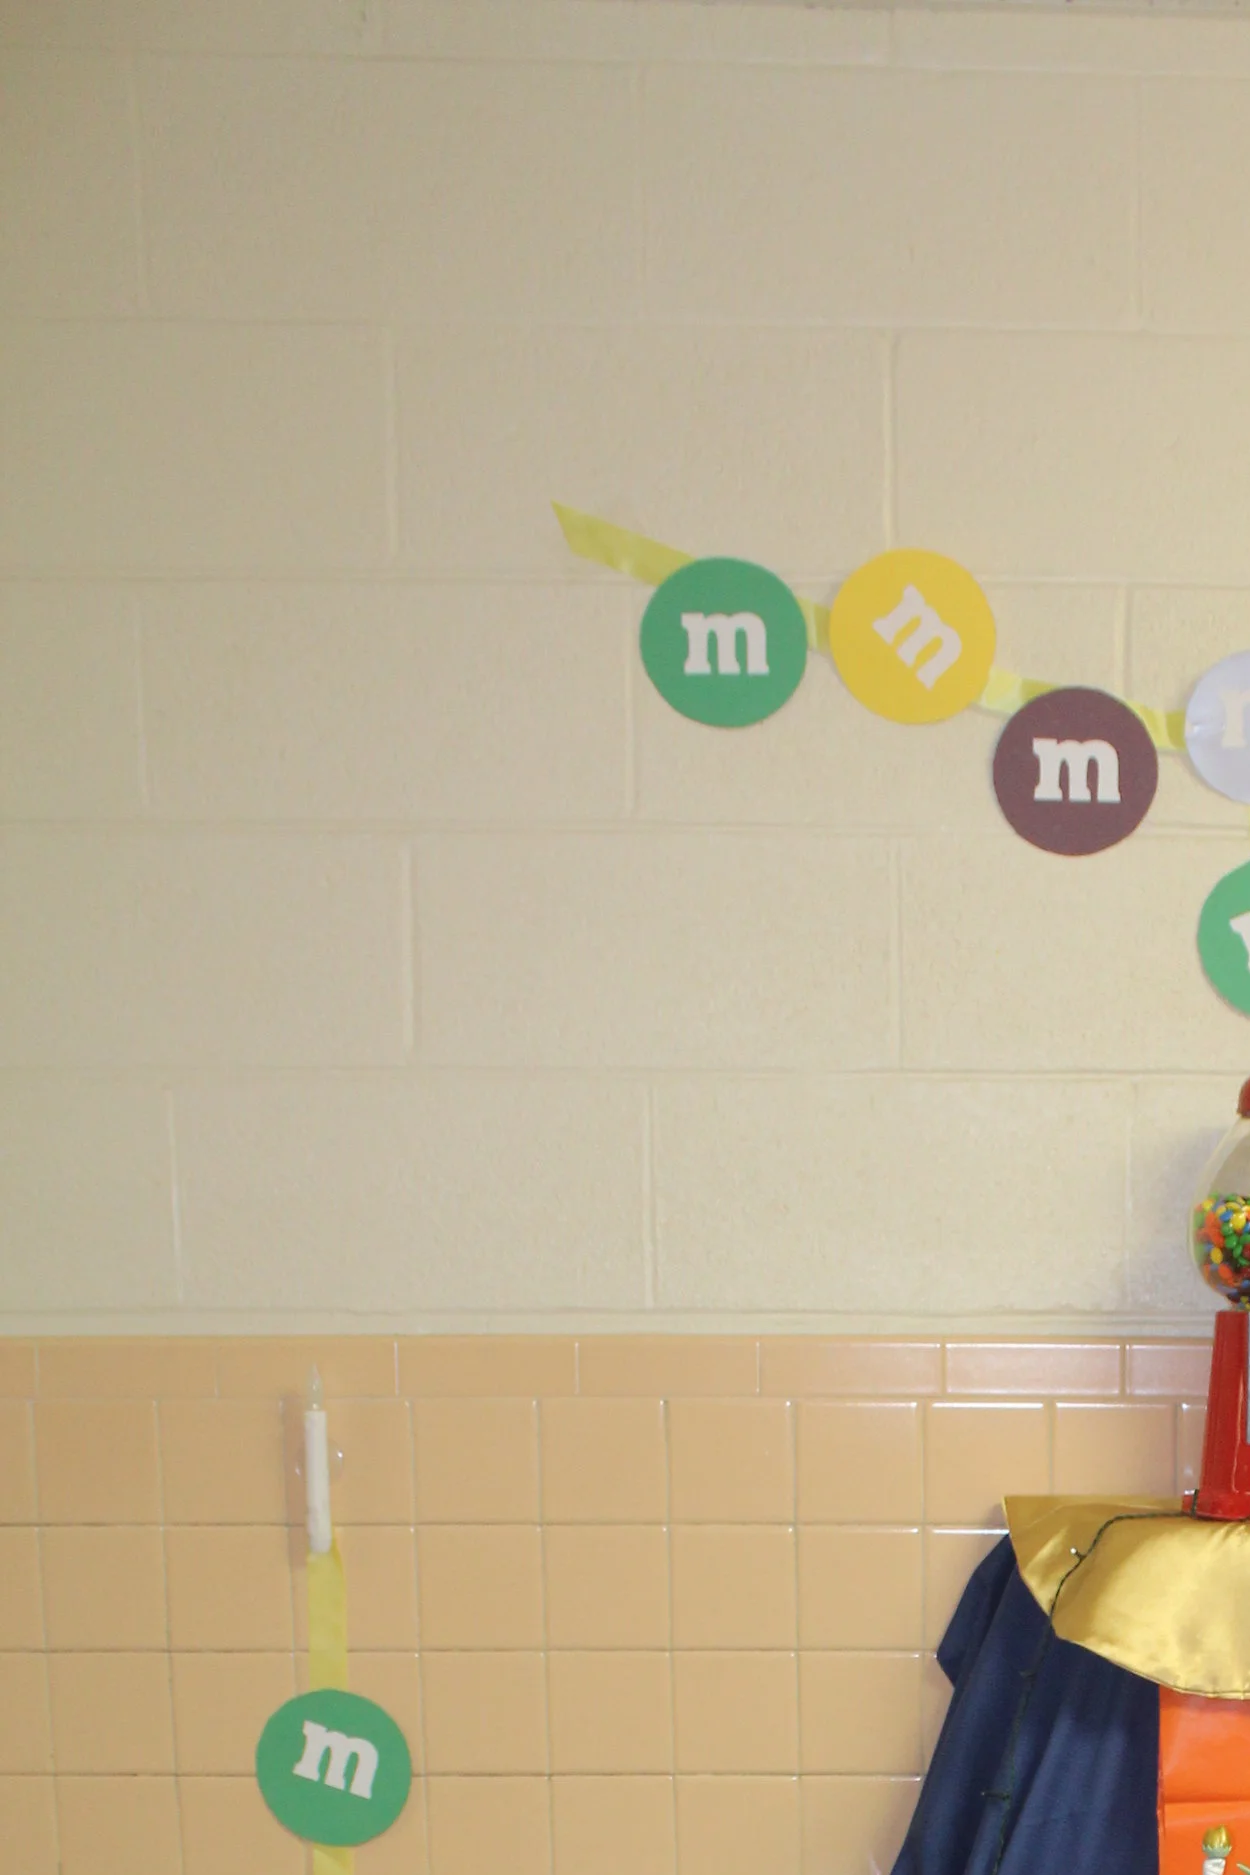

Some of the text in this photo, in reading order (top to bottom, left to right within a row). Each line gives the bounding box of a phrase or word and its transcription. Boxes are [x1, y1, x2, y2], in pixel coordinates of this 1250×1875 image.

[681, 611, 769, 676] m
[872, 583, 963, 690] m
[1032, 737, 1121, 803] m
[292, 1720, 379, 1799] m
